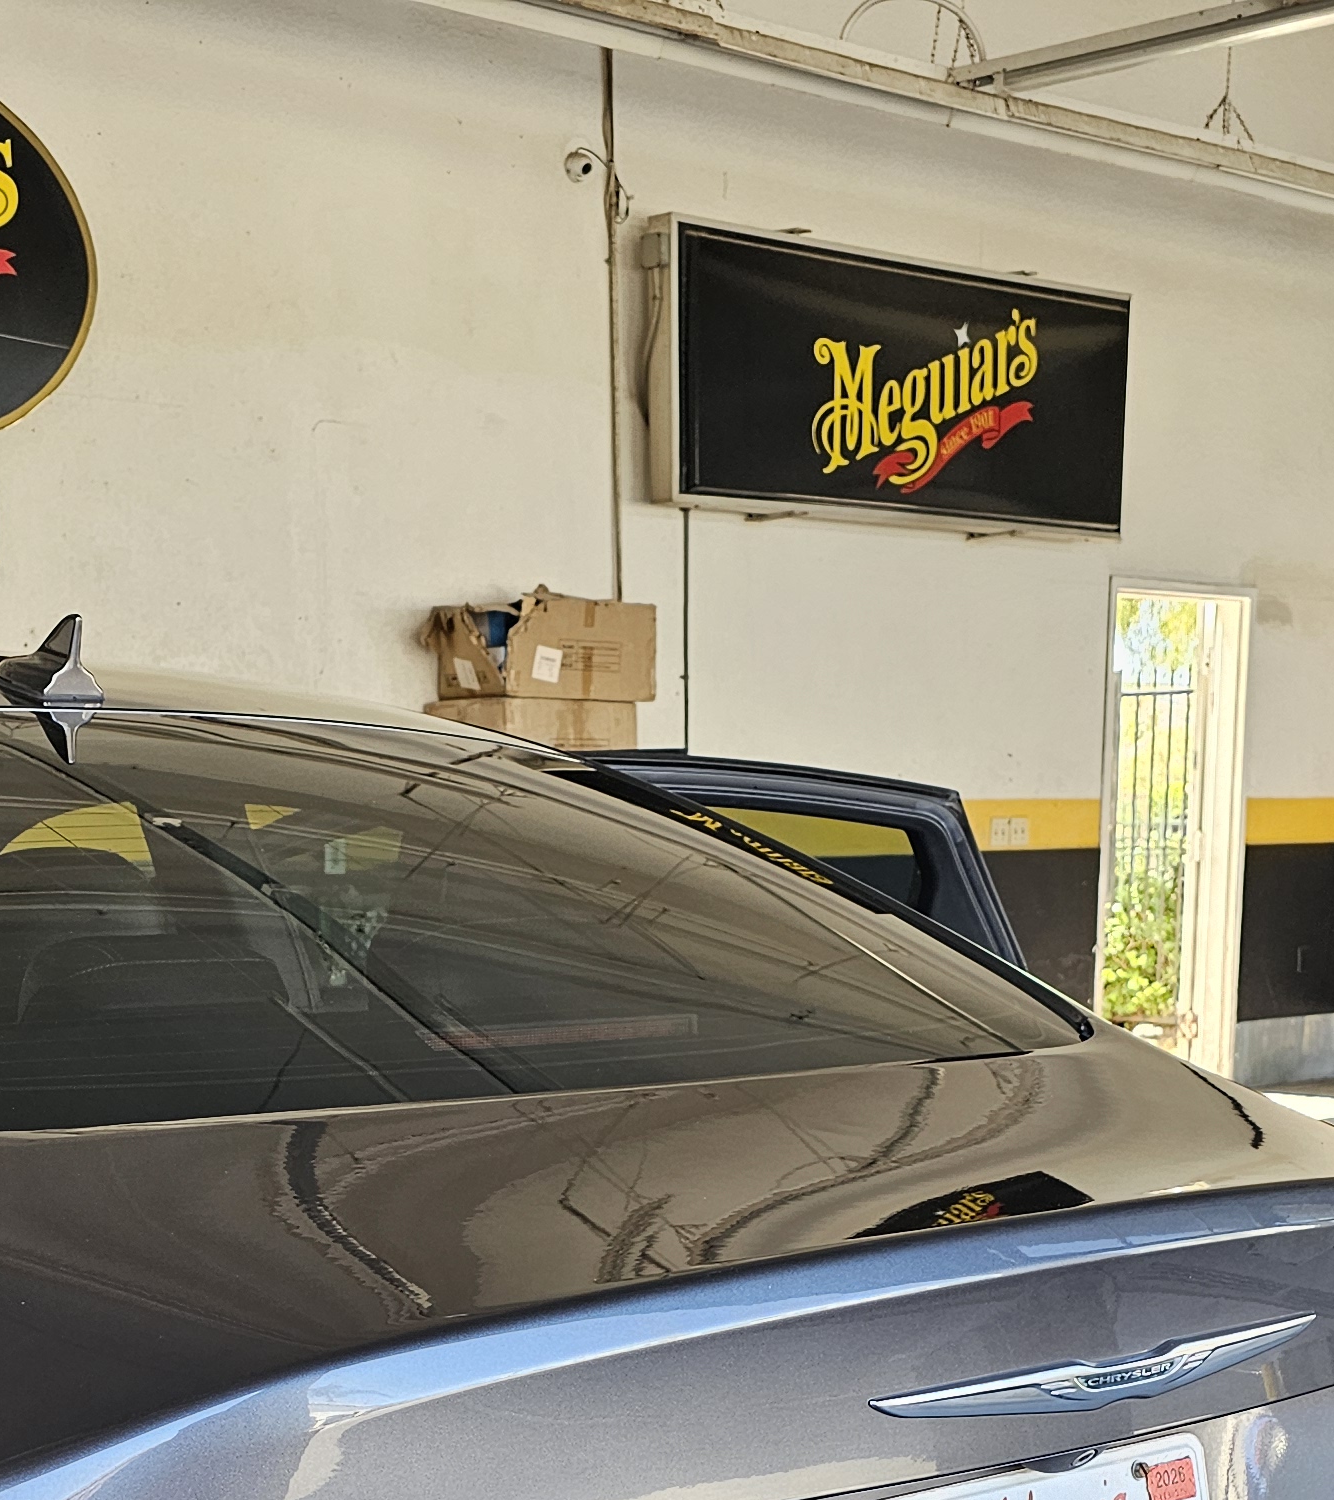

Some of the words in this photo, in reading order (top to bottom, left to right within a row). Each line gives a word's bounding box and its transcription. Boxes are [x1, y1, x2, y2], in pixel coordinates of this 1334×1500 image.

[810, 308, 1039, 485] Meguiar's
[940, 426, 970, 457] since
[1087, 1361, 1171, 1387] CHRYSLER
[1155, 1465, 1186, 1489] 2026
